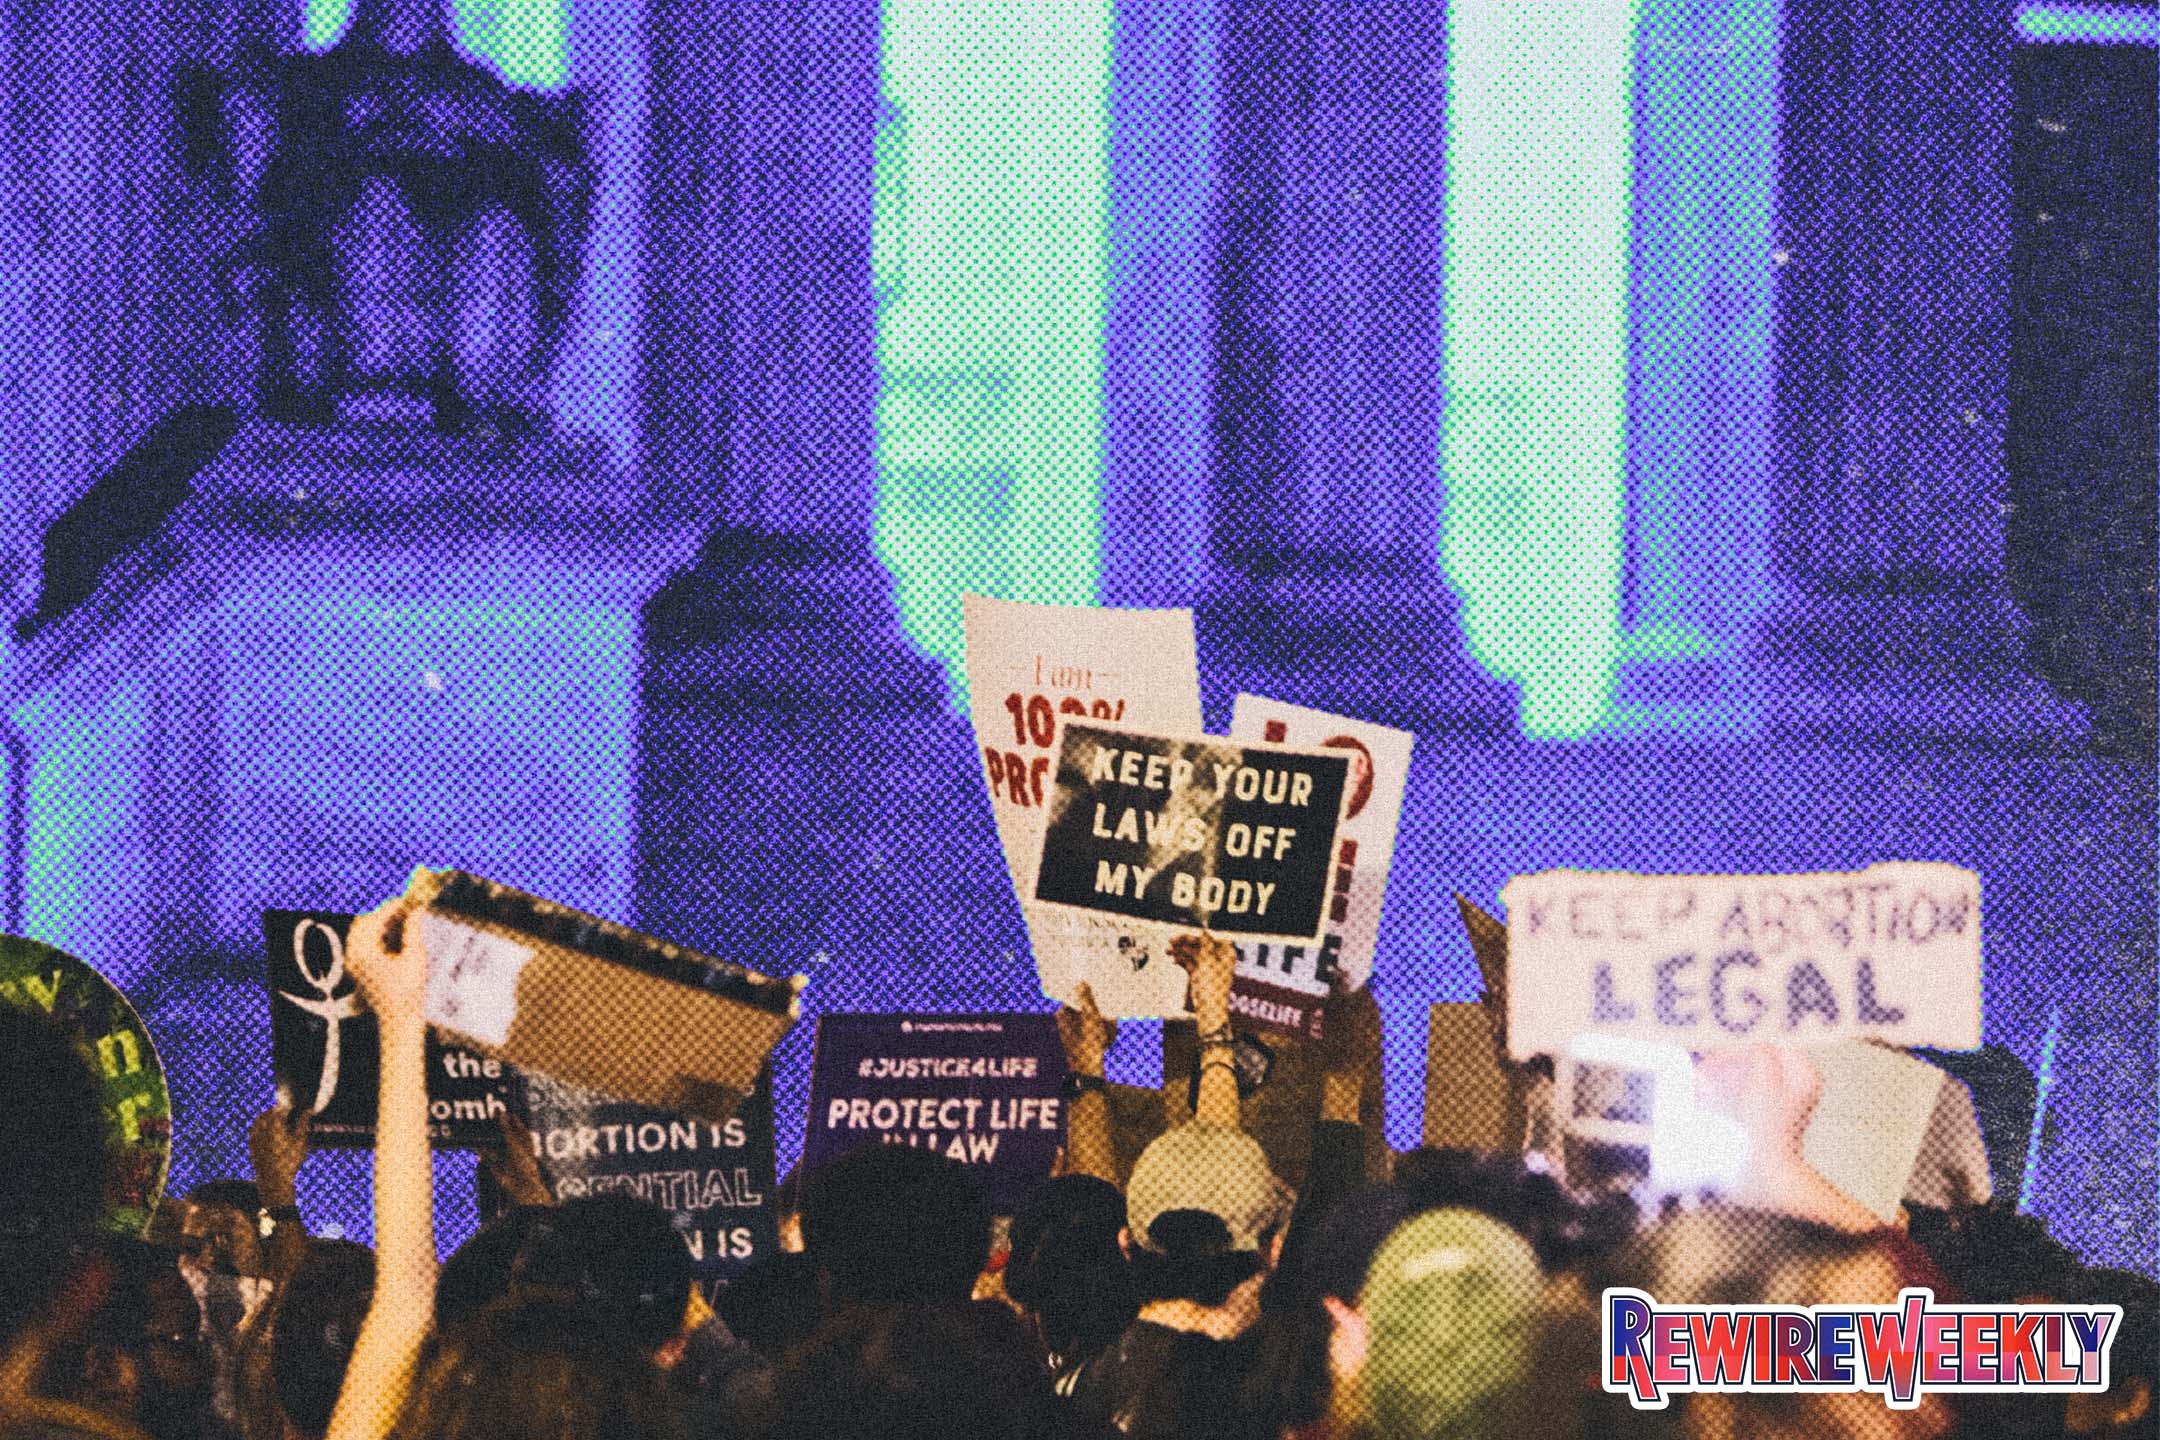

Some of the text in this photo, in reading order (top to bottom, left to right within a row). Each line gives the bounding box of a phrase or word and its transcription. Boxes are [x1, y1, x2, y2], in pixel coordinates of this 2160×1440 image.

[1051, 666, 1092, 690] am
[1091, 746, 1313, 807] KEEP YOUR
[1092, 802, 1296, 861] LAWS OFF
[1095, 860, 1276, 916] MY BODY
[1528, 888, 1696, 940] KEEP
[1592, 948, 1905, 1033] LEGAL
[443, 1051, 501, 1078] the
[858, 1057, 1038, 1078] #JUSTICE4LIFE
[827, 1099, 1060, 1130] PROTECT LIFE
[711, 1118, 746, 1149] IS
[717, 1227, 752, 1259] IS
